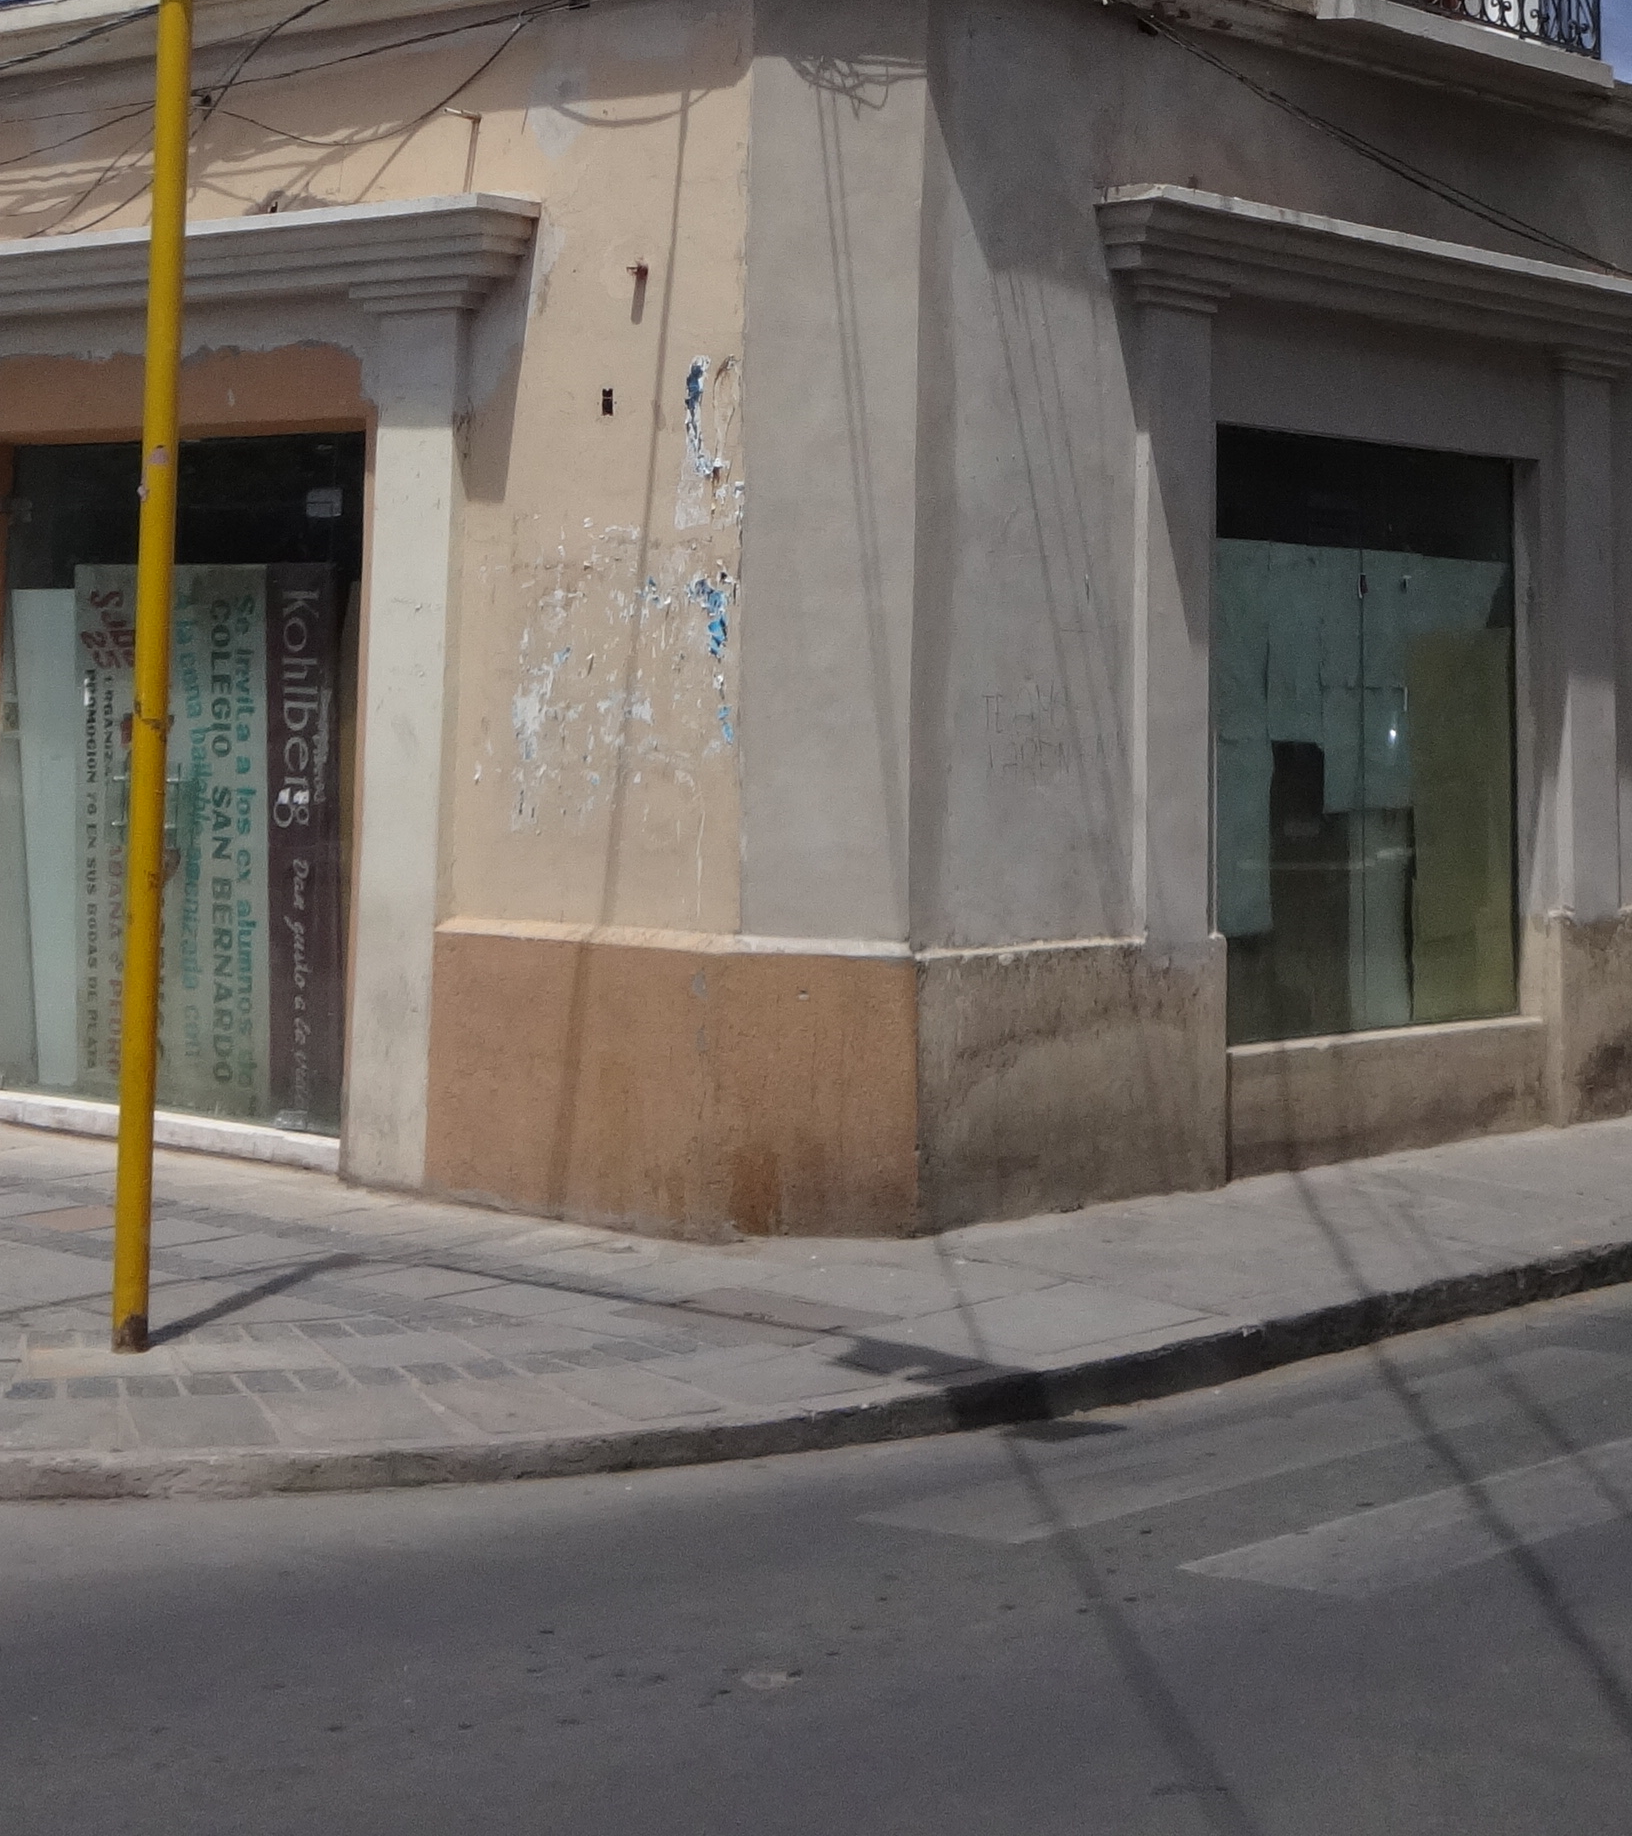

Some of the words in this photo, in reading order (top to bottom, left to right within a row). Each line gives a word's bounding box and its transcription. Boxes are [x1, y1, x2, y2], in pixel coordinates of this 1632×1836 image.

[210, 599, 233, 759] COLEGIO
[272, 588, 320, 830] Kohlberg
[235, 755, 253, 775] a
[211, 786, 233, 860] SAN
[235, 788, 257, 835] los
[85, 857, 99, 895] SUS
[85, 902, 99, 969] BODAS
[236, 898, 257, 1036] alumnos
[211, 876, 234, 1086] BERNARDO
